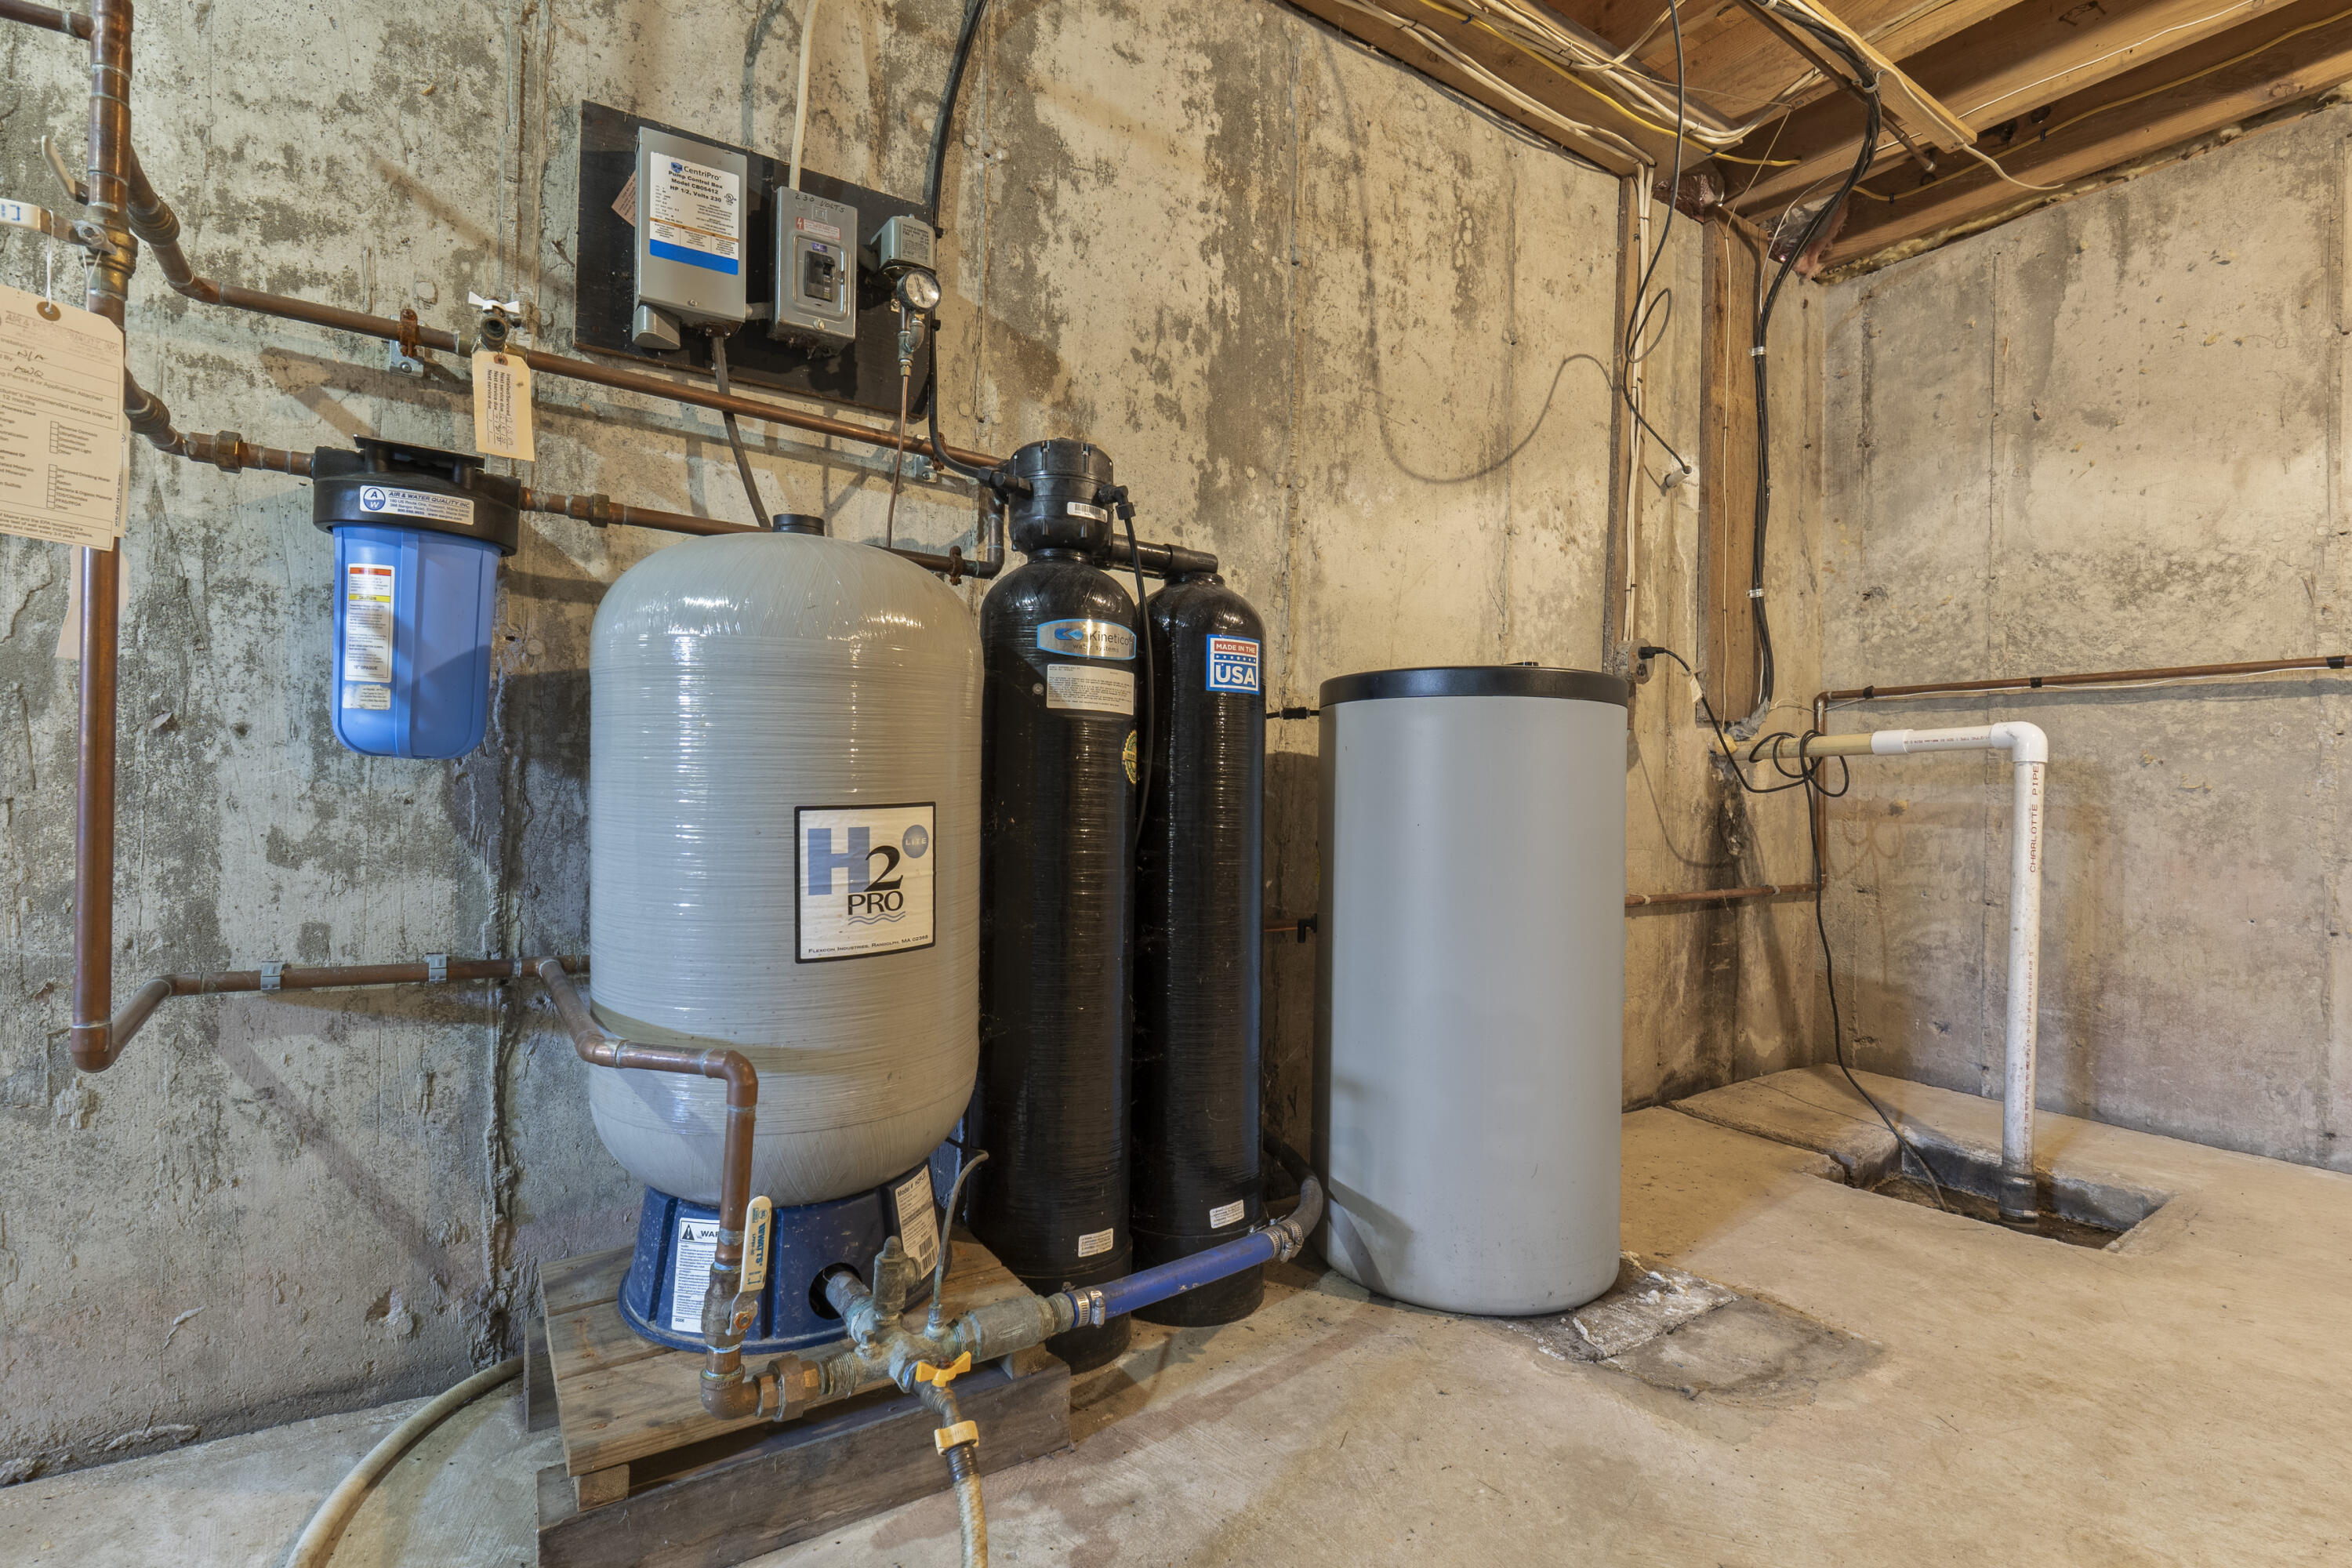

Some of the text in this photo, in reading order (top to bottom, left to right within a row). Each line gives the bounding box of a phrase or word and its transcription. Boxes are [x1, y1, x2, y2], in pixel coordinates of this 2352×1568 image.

[684, 166, 719, 180] CentriPro
[672, 178, 689, 187] Model
[688, 176, 709, 185] Control
[820, 201, 845, 212] VOLTS
[43, 381, 76, 395] Application
[12, 396, 34, 407] months
[24, 392, 68, 409] recommended
[70, 405, 90, 415] service
[92, 410, 112, 420] interval
[431, 496, 458, 506] QUALITY
[1089, 630, 1130, 646] Kinetico
[1216, 665, 1255, 685] USA
[905, 837, 927, 846] LITE
[2030, 803, 2038, 873] CHARLOTTE
[848, 890, 904, 916] PRO
[898, 1185, 909, 1196] Model
[756, 1233, 765, 1264] WATTS
